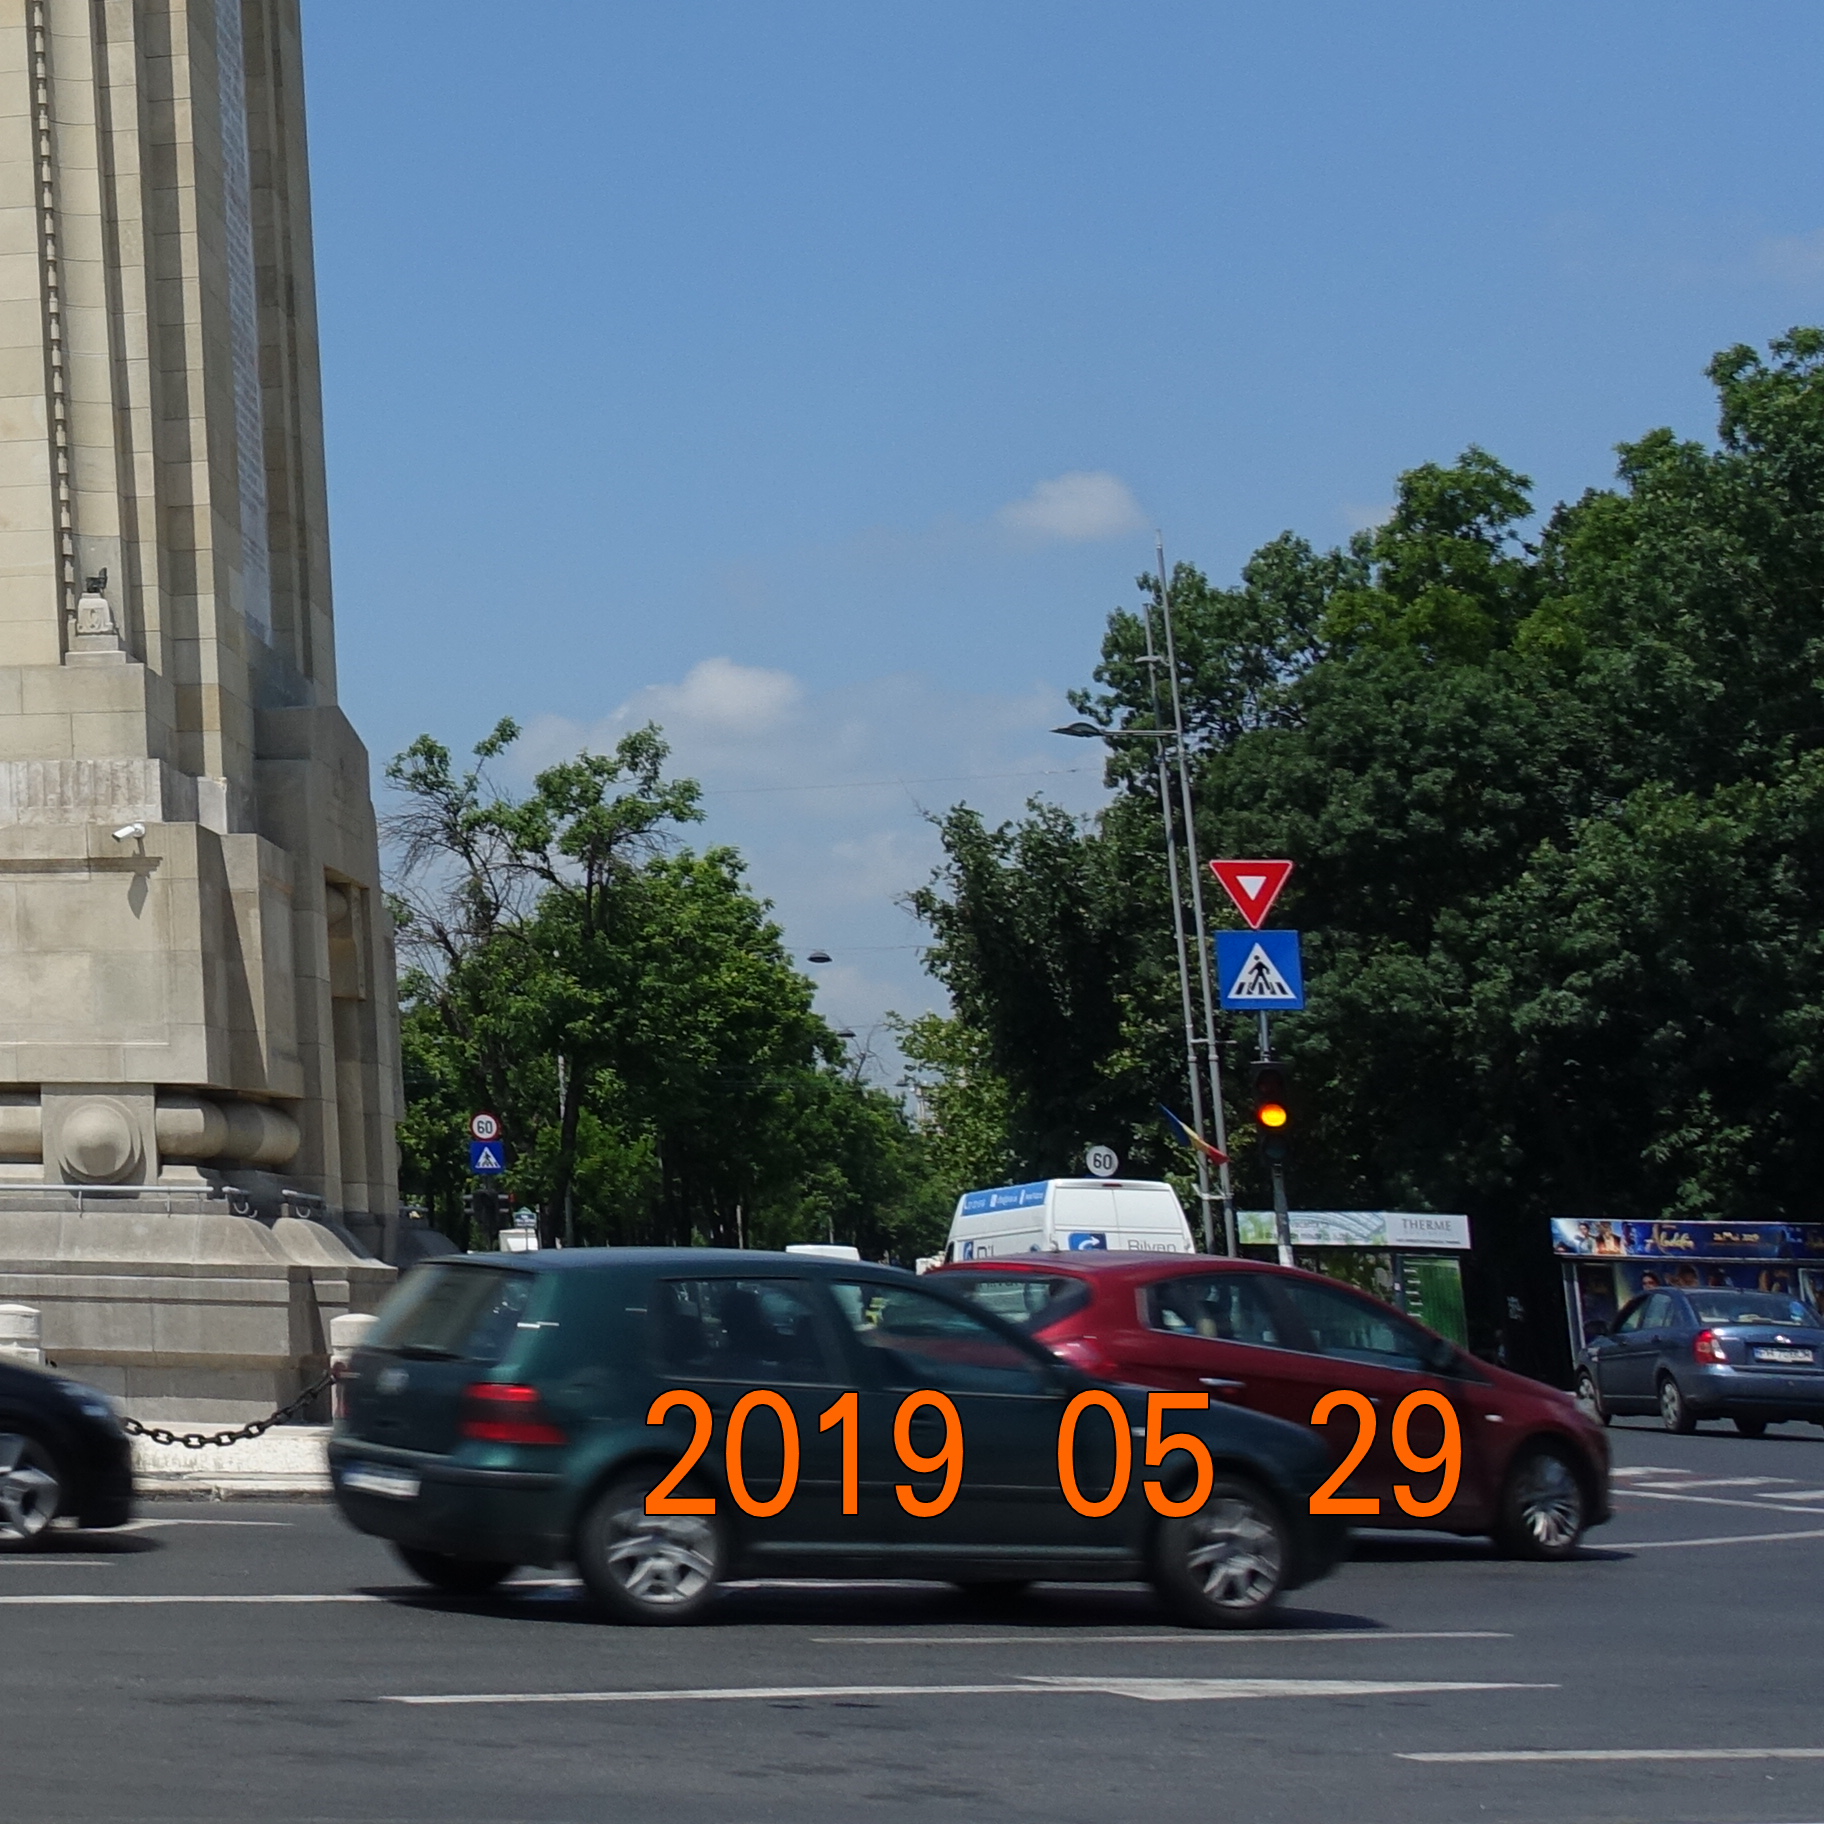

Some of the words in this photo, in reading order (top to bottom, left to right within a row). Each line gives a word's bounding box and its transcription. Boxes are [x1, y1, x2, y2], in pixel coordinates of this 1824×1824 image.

[476, 1120, 494, 1135] 60
[1093, 1152, 1113, 1171] 60
[1402, 1218, 1453, 1232] THERME
